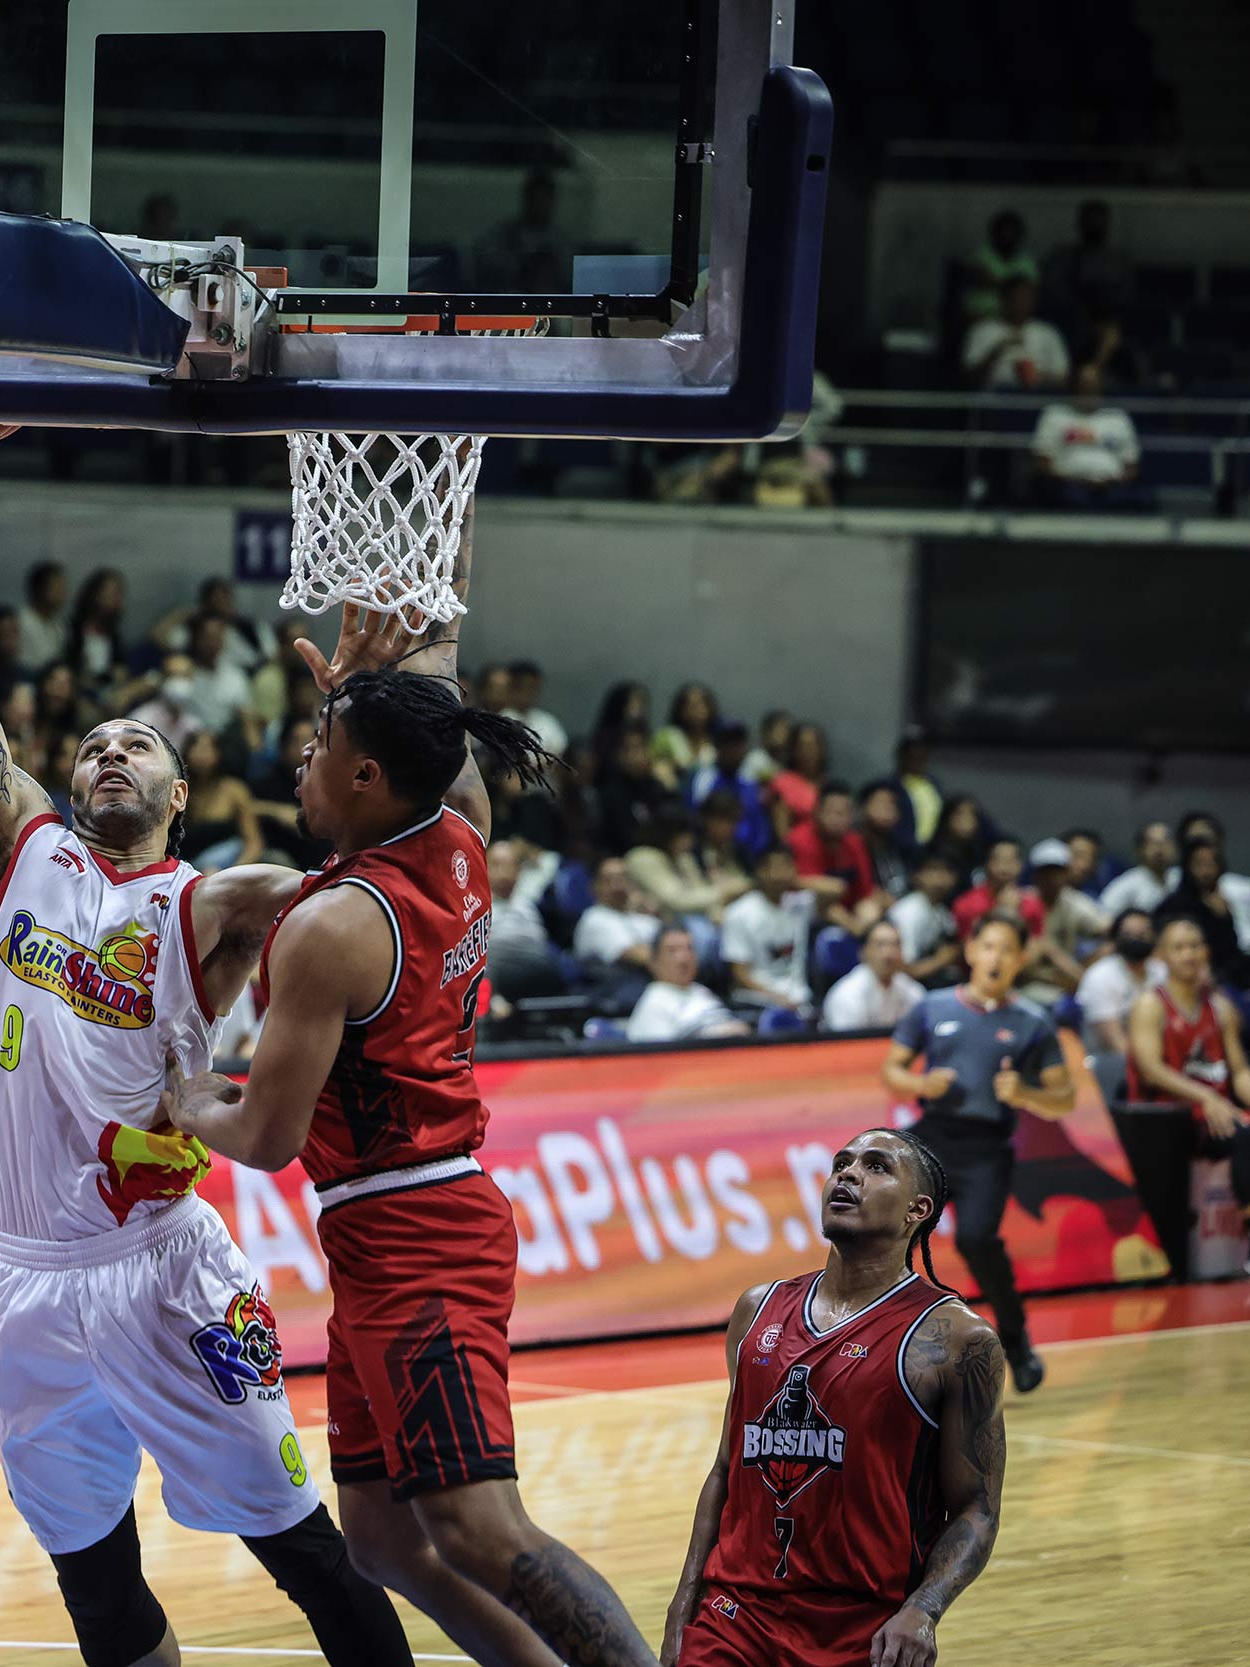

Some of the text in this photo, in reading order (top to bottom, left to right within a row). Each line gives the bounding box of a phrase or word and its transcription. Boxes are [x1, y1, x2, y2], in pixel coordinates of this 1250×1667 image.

[49, 853, 73, 870] ANTA
[150, 893, 170, 911] PB
[440, 909, 493, 990] BAREFIE
[6, 910, 153, 1024] Rain OR Shine
[23, 966, 66, 991] ELASTO
[839, 1341, 869, 1358] PBA
[279, 1432, 306, 1487] 9
[743, 1423, 845, 1463] BOSSING
[774, 1517, 795, 1579] 7
[711, 1594, 740, 1620] PBA
